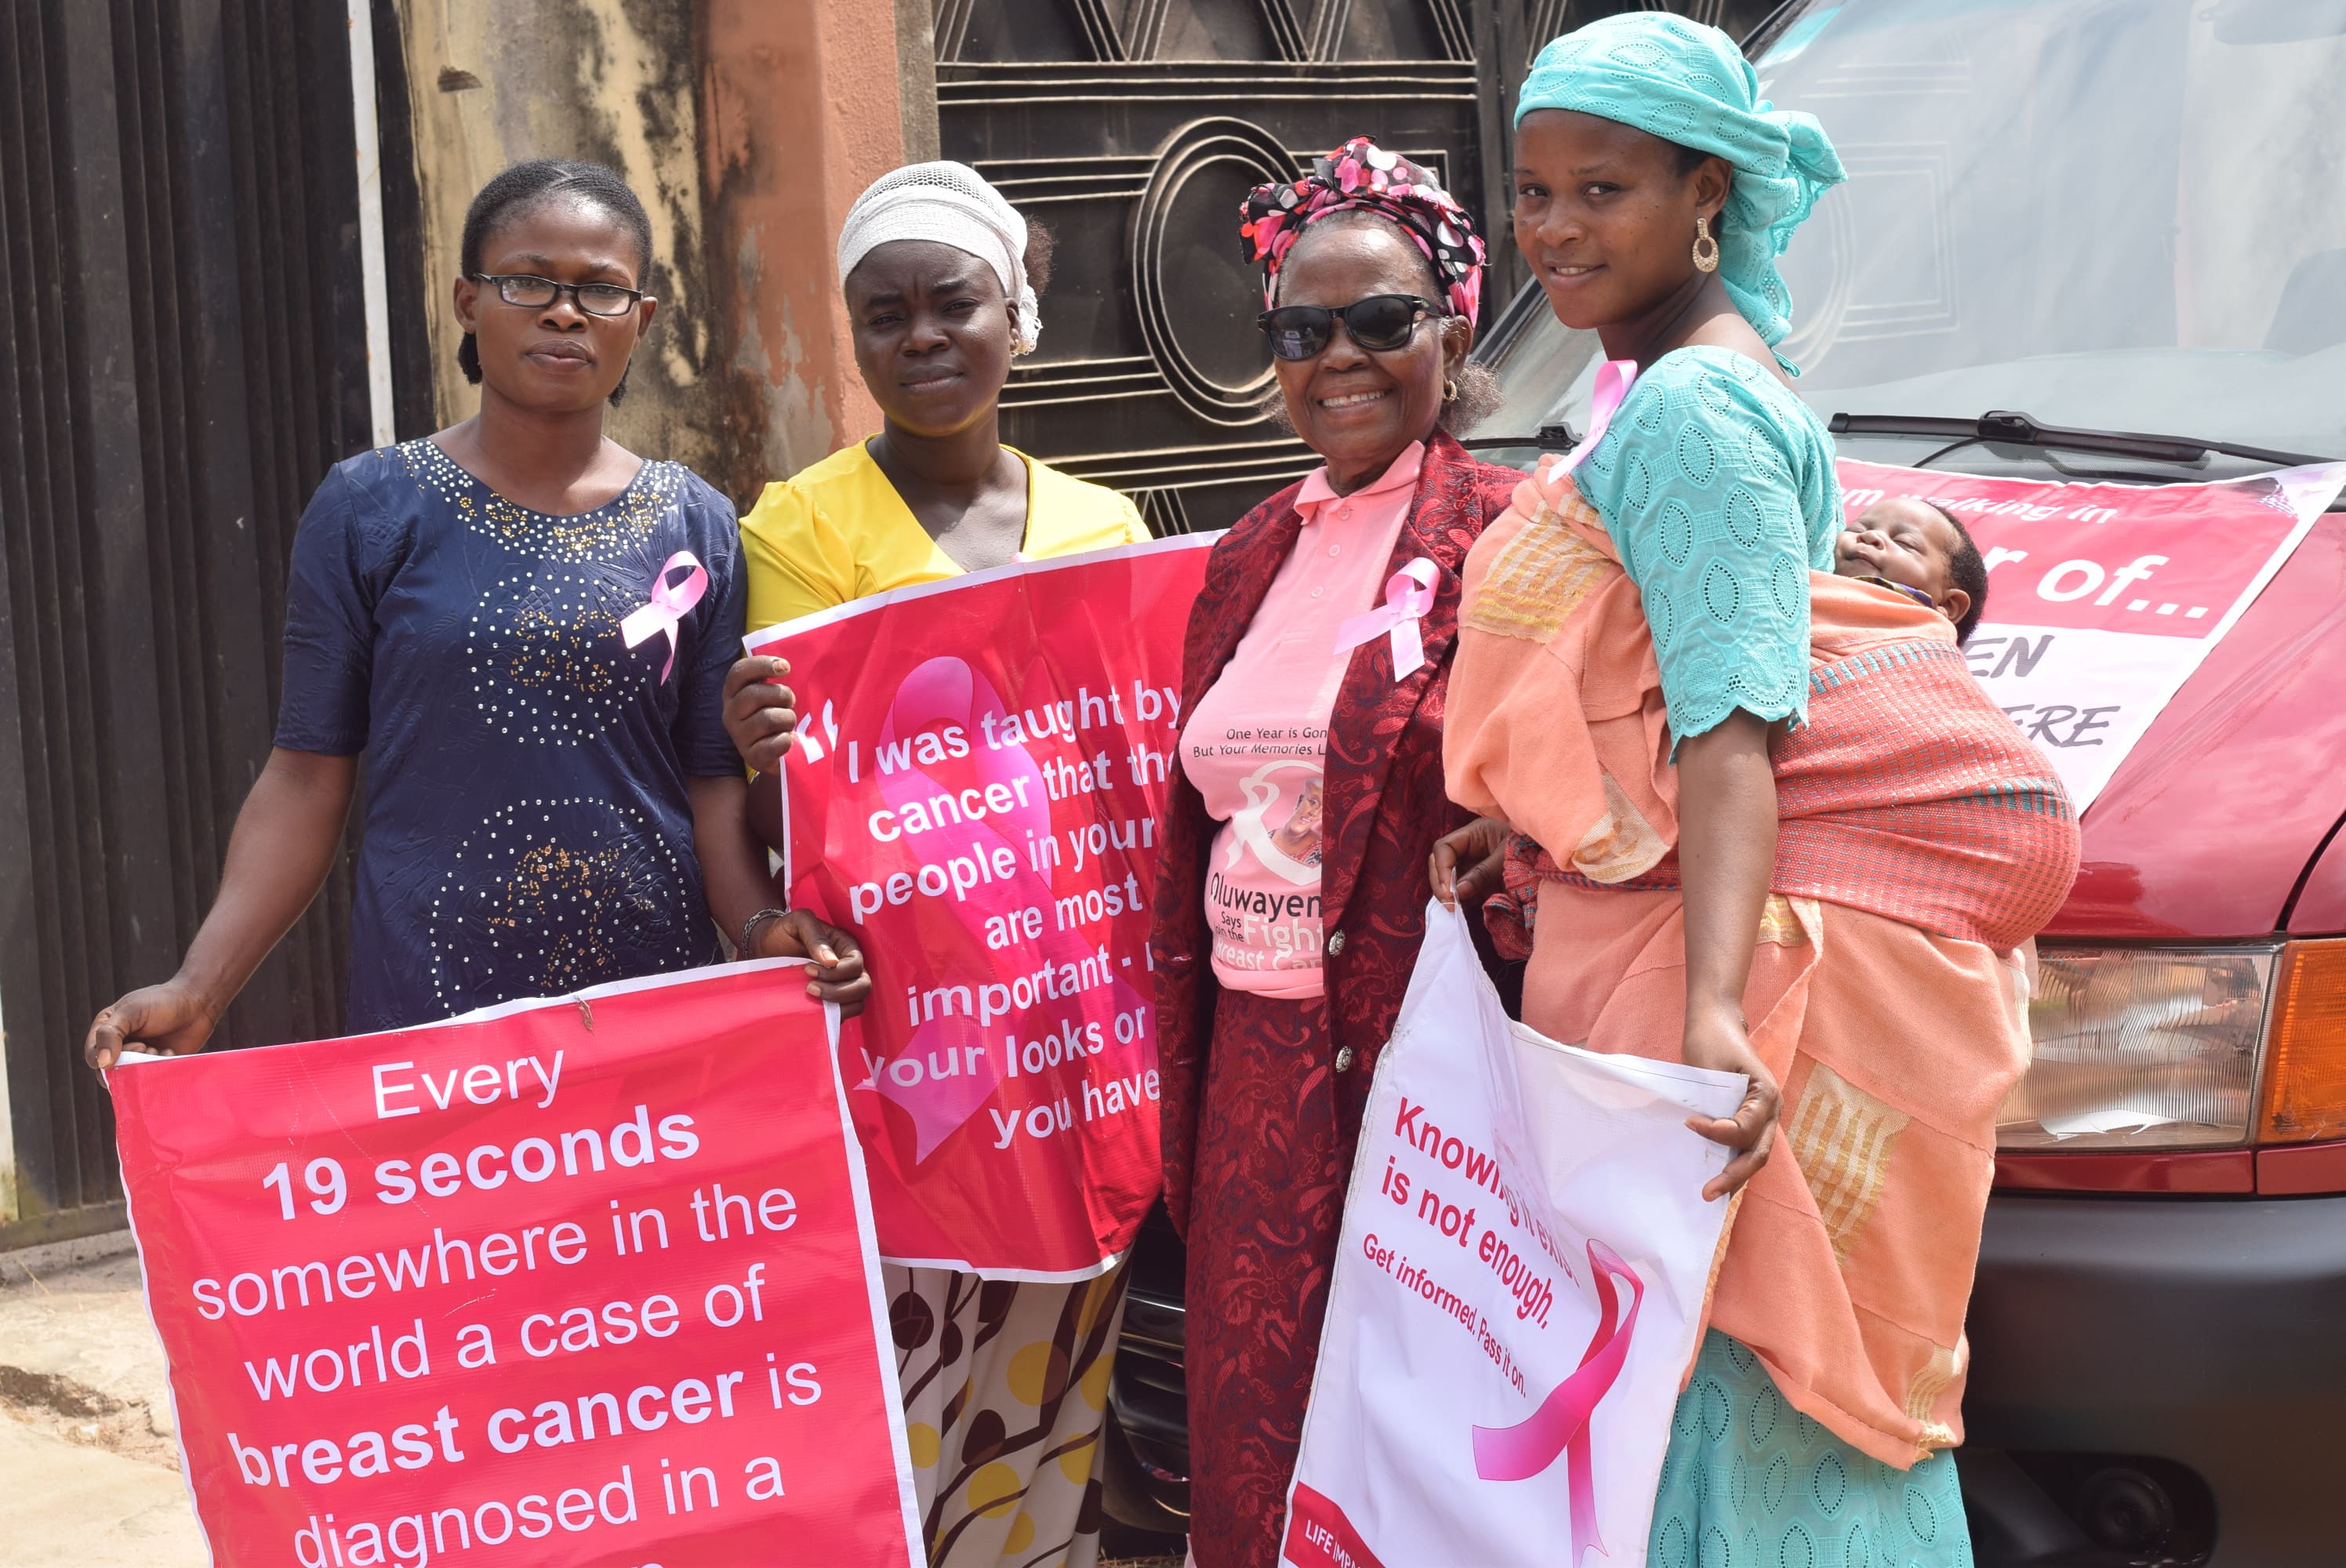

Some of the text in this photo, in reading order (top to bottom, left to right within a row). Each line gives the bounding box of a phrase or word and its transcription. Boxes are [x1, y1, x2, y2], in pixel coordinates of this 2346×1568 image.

[2067, 504, 2118, 524] in
[2036, 554, 2209, 619] of...
[876, 726, 970, 775] was
[981, 685, 1124, 751] taught
[1134, 680, 1182, 729] by
[1193, 746, 1214, 758] But
[1219, 744, 1247, 756] Your
[1251, 743, 1312, 755] Memories
[1226, 728, 1251, 740] One
[1256, 728, 1284, 739] Year
[1288, 727, 1297, 739] is
[869, 743, 1175, 843] cancer that th
[849, 817, 1155, 925] people in your
[985, 872, 1143, 950] are most
[1221, 911, 1241, 930] Says
[1228, 927, 1244, 942] the
[908, 943, 1113, 1027] important
[372, 1050, 564, 1120] Every
[860, 1006, 1146, 1087] your looks or
[989, 1069, 1160, 1149] you have
[262, 1105, 700, 1221] 19 seconds
[193, 1183, 797, 1320] somewhere in the
[1382, 1155, 1553, 1330] is not enough.
[245, 1263, 765, 1401] world a case of
[1364, 1233, 1526, 1398] Get informed. Pass it on.
[227, 1352, 822, 1488] breast cancer is
[294, 1456, 786, 1568] diagnosed in a
[1305, 1519, 1335, 1554] LIFE
